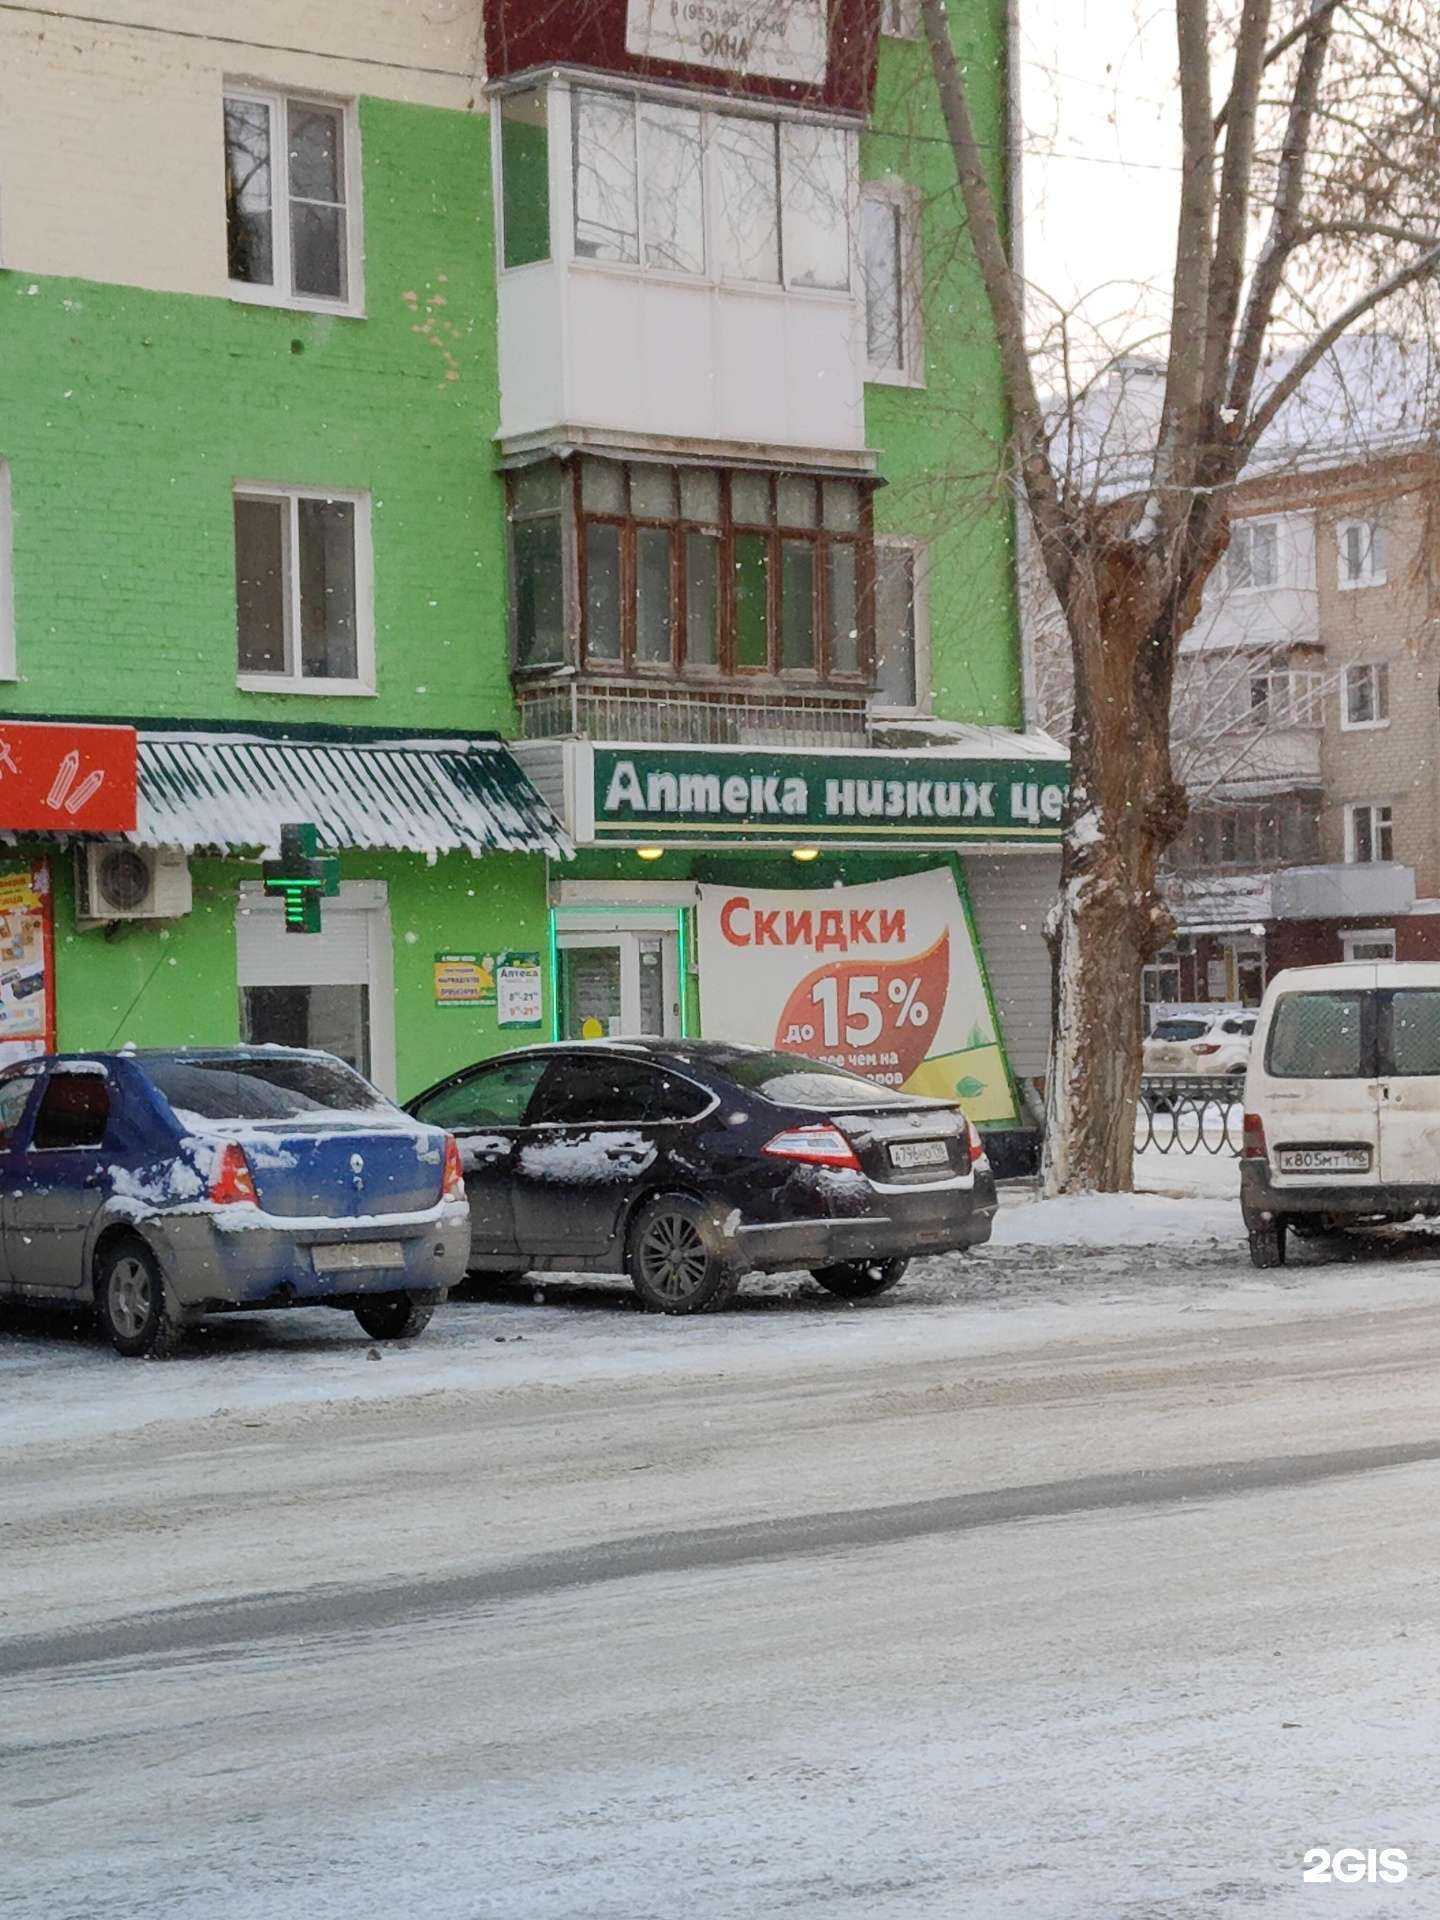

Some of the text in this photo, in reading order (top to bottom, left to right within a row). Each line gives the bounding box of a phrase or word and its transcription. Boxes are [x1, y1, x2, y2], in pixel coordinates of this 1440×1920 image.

[603, 760, 1069, 823] Аптека низких це
[720, 896, 907, 952] Скидки
[500, 968, 539, 978] Аптека
[782, 974, 930, 1049] до 15%
[848, 1053, 877, 1067] чем
[879, 1051, 899, 1065] на
